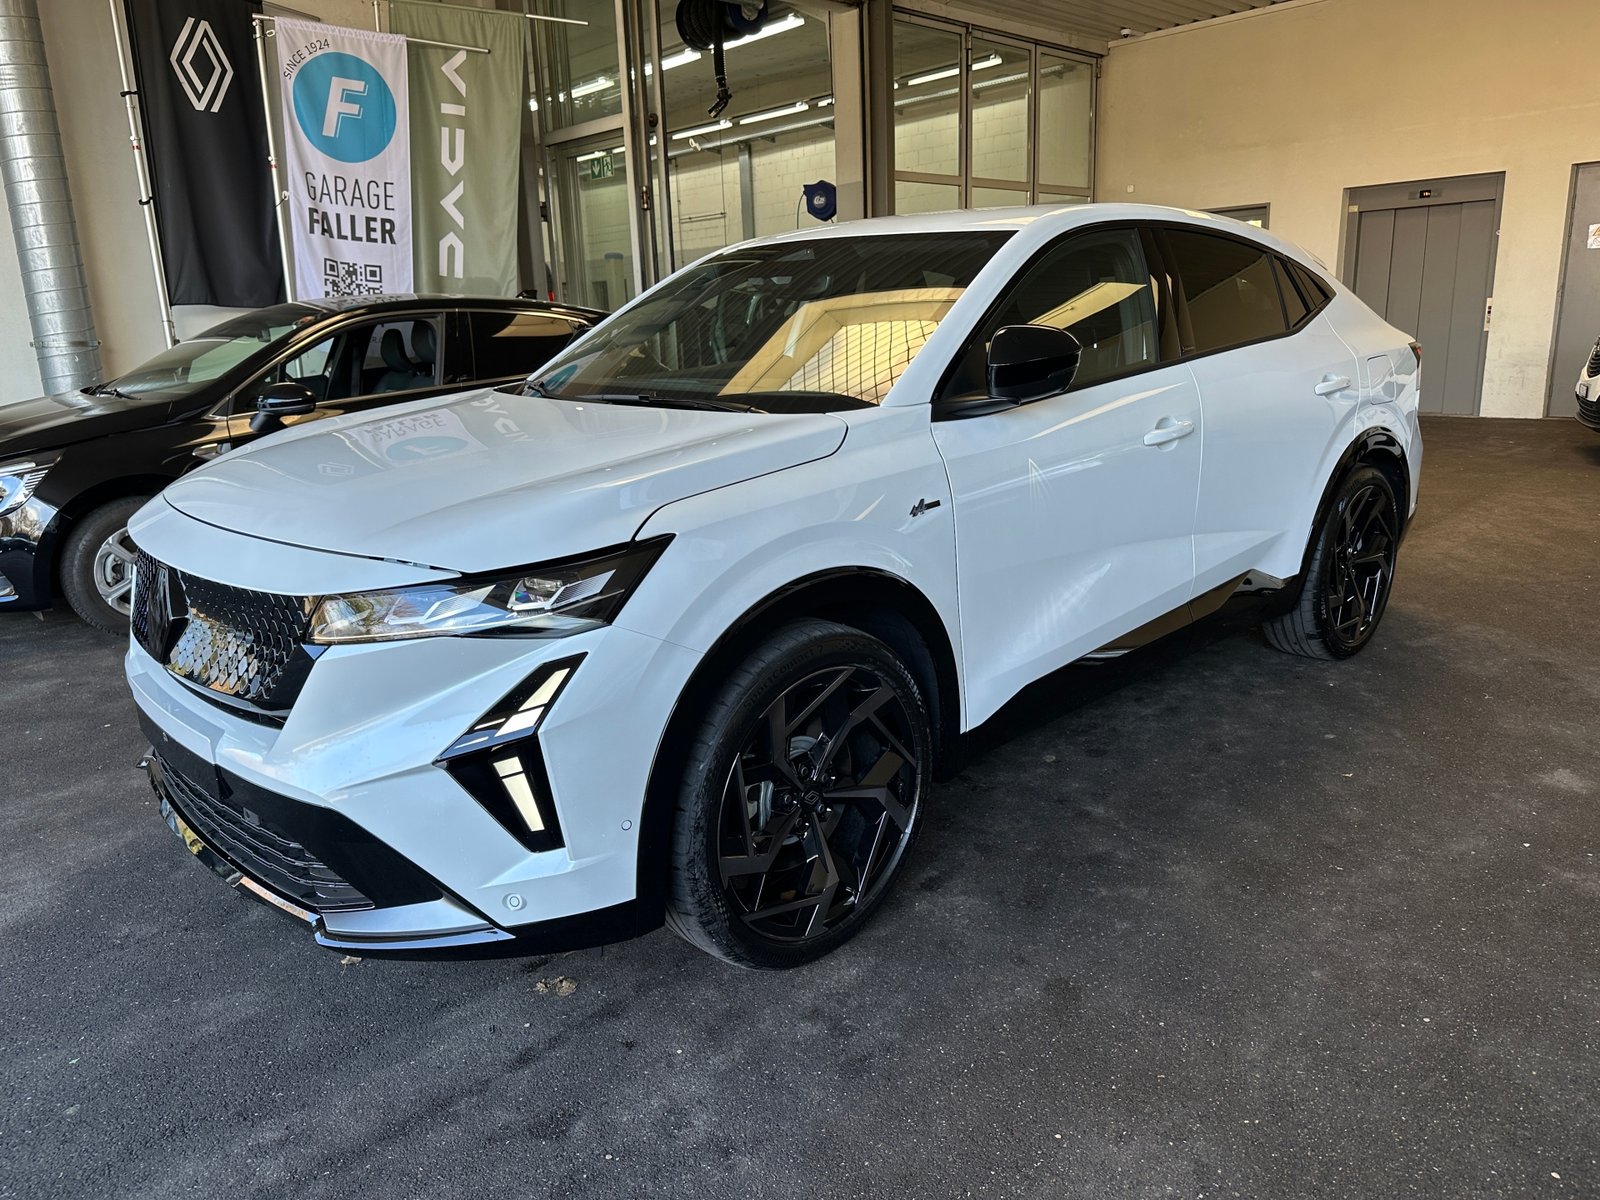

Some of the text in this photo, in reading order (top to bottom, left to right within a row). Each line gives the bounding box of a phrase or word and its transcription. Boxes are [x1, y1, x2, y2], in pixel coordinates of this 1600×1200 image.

[283, 38, 330, 79] SINCE 1924
[322, 76, 369, 138] F
[439, 50, 467, 279] DACIA
[305, 171, 395, 211] GARAGE
[308, 207, 397, 245] FALLER
